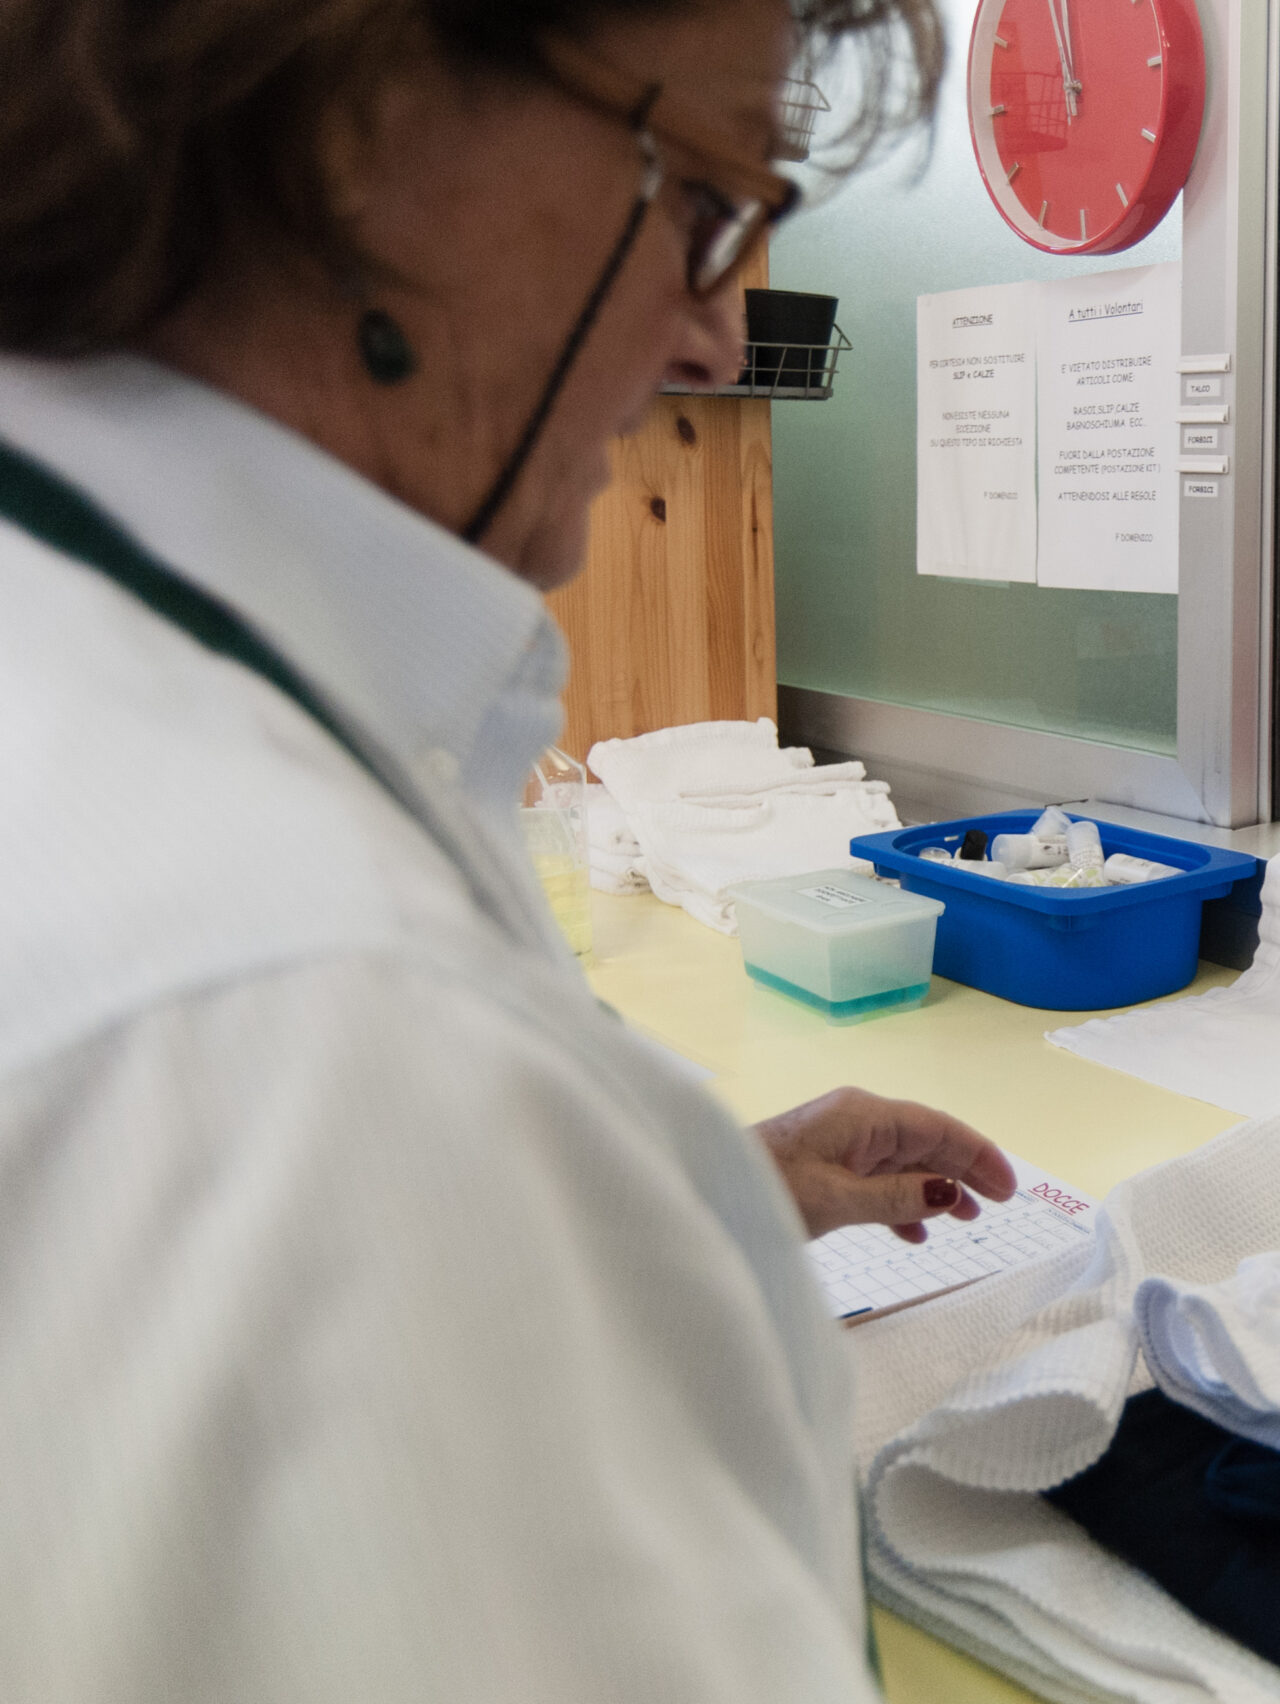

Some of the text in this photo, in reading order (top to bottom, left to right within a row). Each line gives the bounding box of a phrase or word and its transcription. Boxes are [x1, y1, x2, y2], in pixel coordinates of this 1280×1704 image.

[1069, 309, 1075, 319] A
[1077, 306, 1097, 319] tutti
[1104, 299, 1143, 316] Volontari
[966, 356, 982, 366] NON
[1069, 360, 1101, 373] VIETATO
[1102, 355, 1152, 370] DISTRIBUIRE
[972, 368, 995, 379] CALZE
[1076, 375, 1111, 386] ARTICOLI
[1191, 384, 1211, 393] TALCO
[1115, 401, 1141, 413] CALZE
[1188, 435, 1214, 445] FORBICI
[1059, 447, 1155, 460] FUORI DALLA POSTAZIONE
[1054, 463, 1100, 475] COMPETENTE
[1189, 484, 1214, 494] FORBICI
[1058, 490, 1157, 502] ATTENENDOSI ALLE REGOLE
[1031, 1182, 1091, 1215] DOCCE
